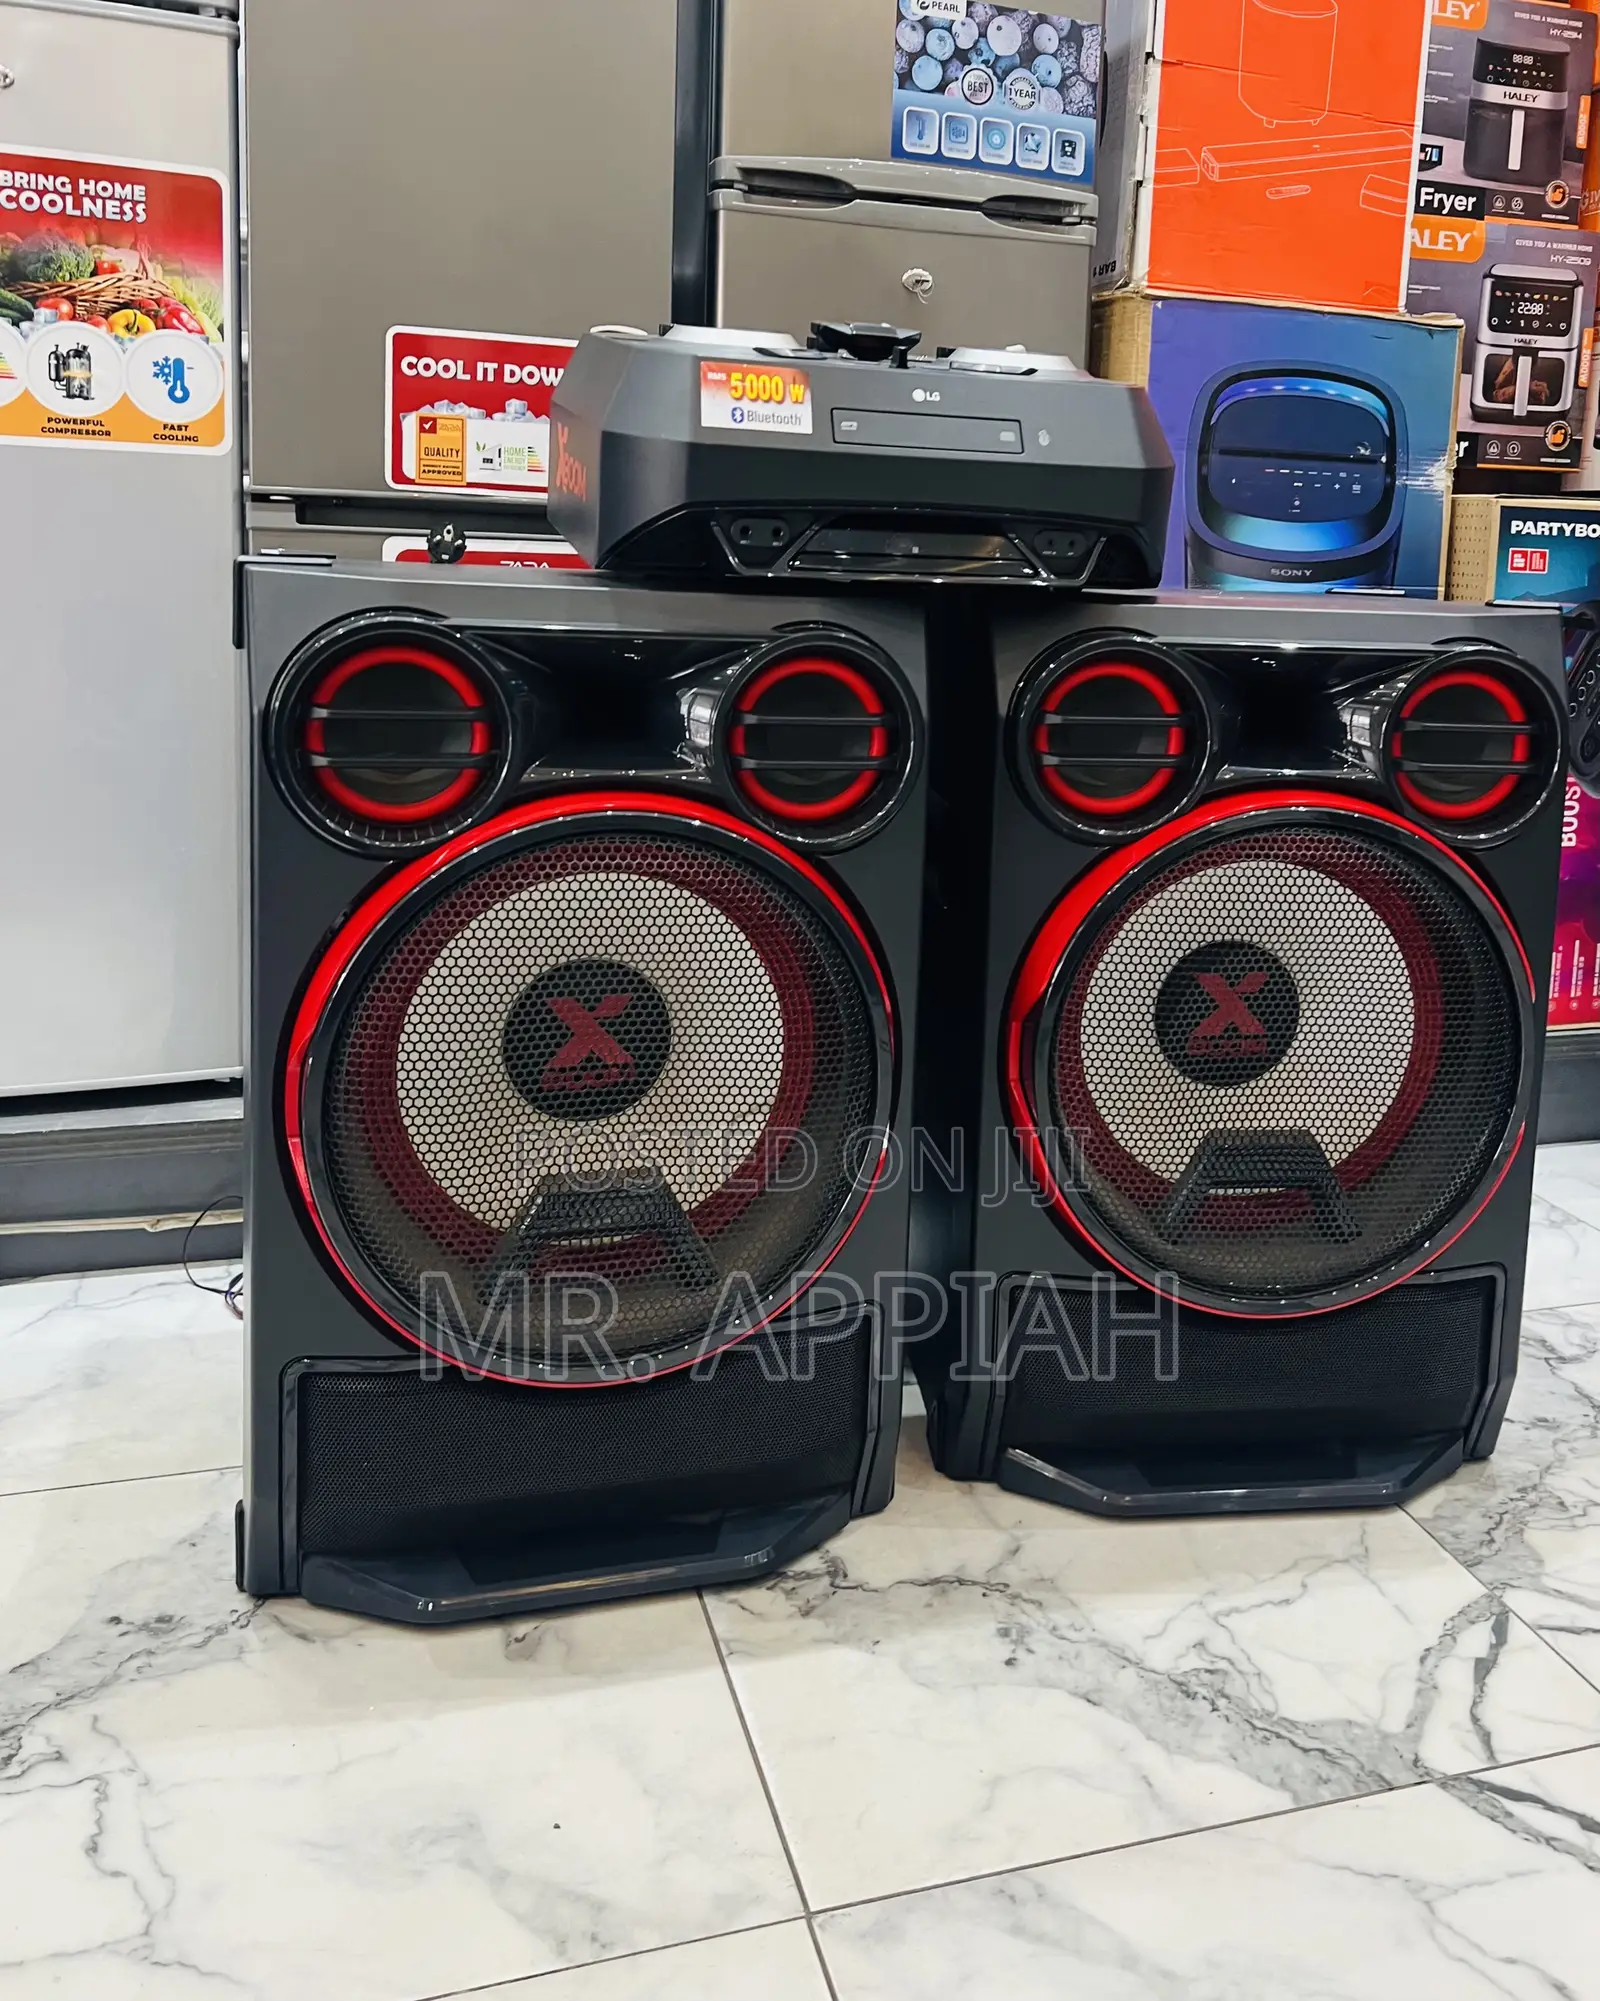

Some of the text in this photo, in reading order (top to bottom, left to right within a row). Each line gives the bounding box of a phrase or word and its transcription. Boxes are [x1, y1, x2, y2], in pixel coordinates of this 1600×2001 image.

[931, 1, 961, 13] PEARL
[967, 81, 989, 93] BEST
[1009, 88, 1037, 99] 1 YEAR
[1503, 91, 1539, 102] HALEY
[0, 169, 146, 201] BRING HOME
[0, 188, 147, 223] COOLNESS
[1419, 186, 1476, 215] Fryer
[401, 355, 564, 387] COOL IT DOW
[707, 371, 727, 381] RMS
[730, 372, 784, 401] 5000
[926, 391, 940, 401] LG
[47, 416, 105, 427] POWERFUL
[747, 410, 802, 426] Bluetooth
[41, 426, 111, 437] COMPRESSOR
[163, 423, 189, 432] FAST
[153, 433, 199, 443] COOLING
[424, 446, 460, 458] QUALITY
[503, 446, 526, 457] HOME
[1270, 567, 1313, 577] SONY
